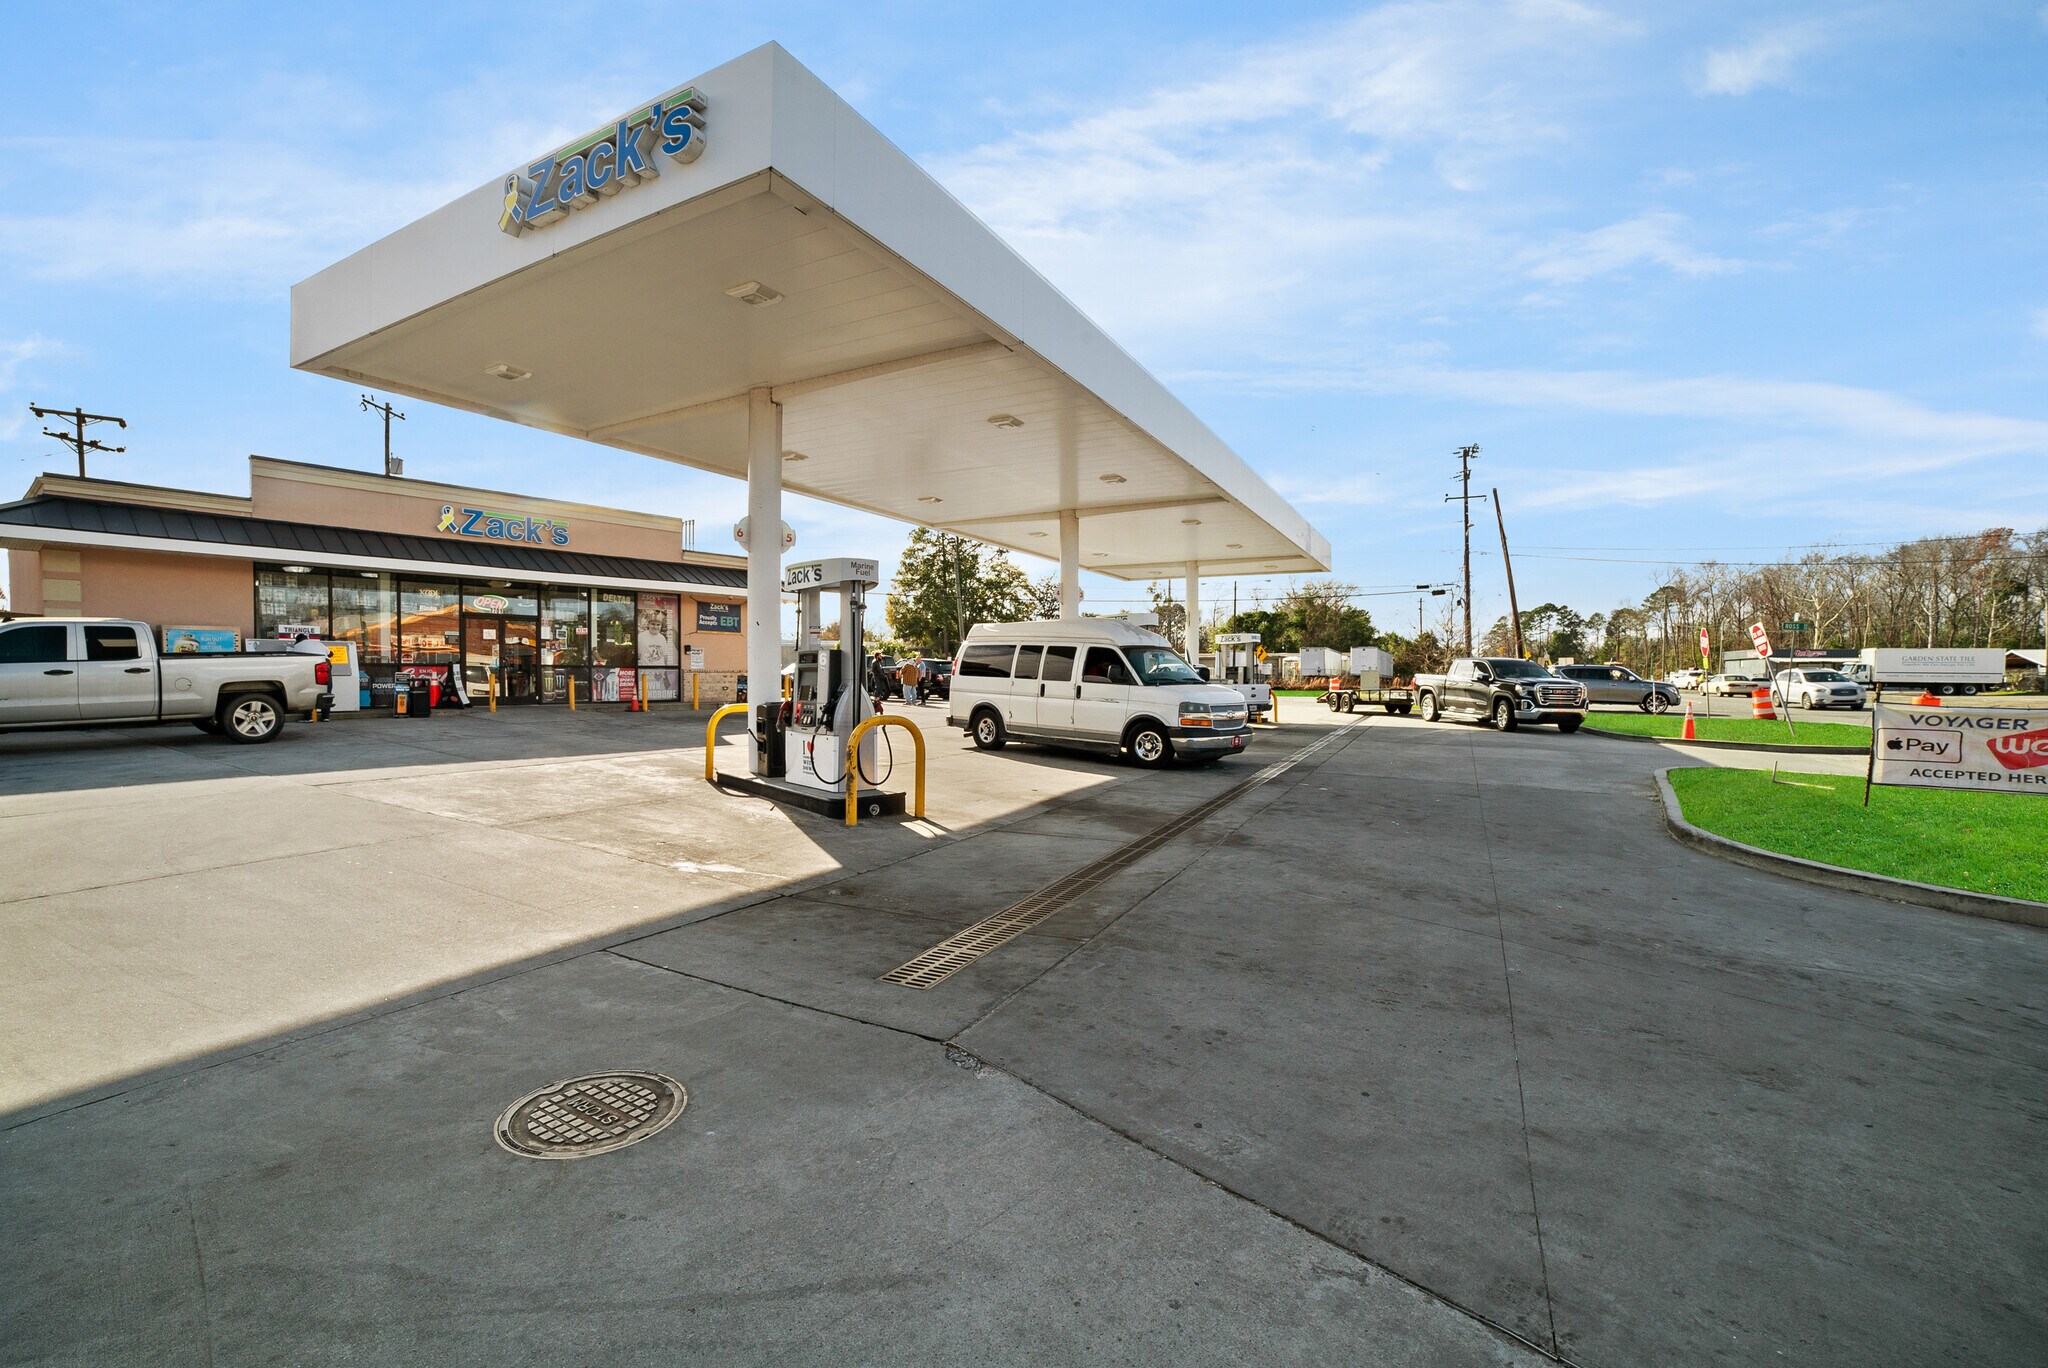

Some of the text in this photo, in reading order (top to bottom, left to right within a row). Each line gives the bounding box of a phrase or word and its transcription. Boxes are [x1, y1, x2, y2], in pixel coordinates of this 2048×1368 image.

[526, 101, 694, 222] Zack's
[460, 507, 569, 546] Zack's
[736, 528, 743, 537] 6
[786, 534, 792, 542] 5
[850, 562, 874, 570] Marine
[855, 569, 870, 577] Fuel
[787, 565, 822, 585] Zack's
[477, 596, 504, 609] OPEN
[720, 616, 739, 627] EBT
[819, 653, 827, 666] 6
[1909, 714, 2029, 730] VOYAGER
[1906, 738, 1949, 755] Pay
[1909, 768, 2048, 784] ACCEPTED HER
[567, 1096, 619, 1124] STORM
